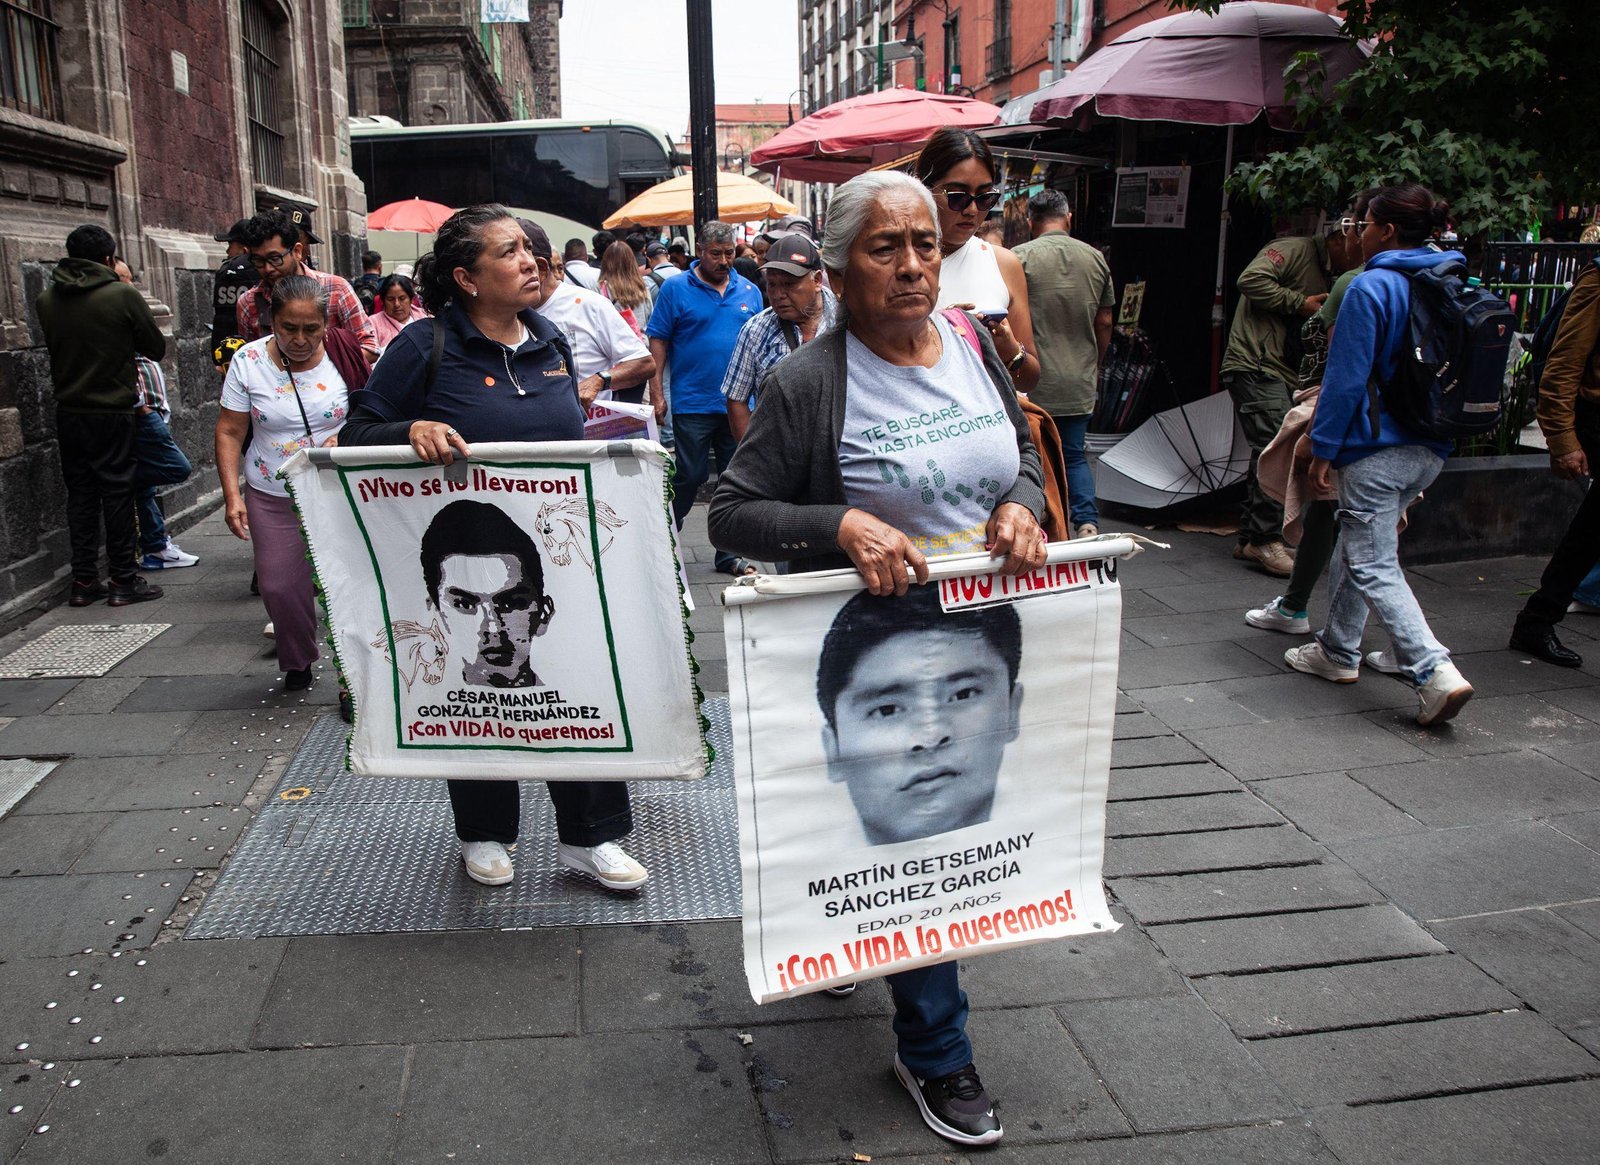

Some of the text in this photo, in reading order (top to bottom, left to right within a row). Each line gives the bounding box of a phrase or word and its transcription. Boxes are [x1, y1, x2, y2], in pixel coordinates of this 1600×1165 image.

[861, 402, 963, 443] TE BUSCARÉ
[359, 477, 414, 502] ¡Vivo
[421, 478, 442, 496] se
[472, 468, 579, 495] llevaron!
[417, 704, 601, 722] GONZÁLEZ HERNÁNDEZ
[446, 689, 567, 707] CÉSAR MANUEL
[408, 721, 615, 743] ¡Con VIDA lo queremos!
[807, 832, 1034, 898] MARTÍN GETSEMANY
[824, 861, 1022, 918] SÁNCHEZ GARCÍA
[857, 892, 1002, 934] EDAD 20 AÑOS
[777, 890, 1076, 992] ¡Con VIDA lo queremos!
